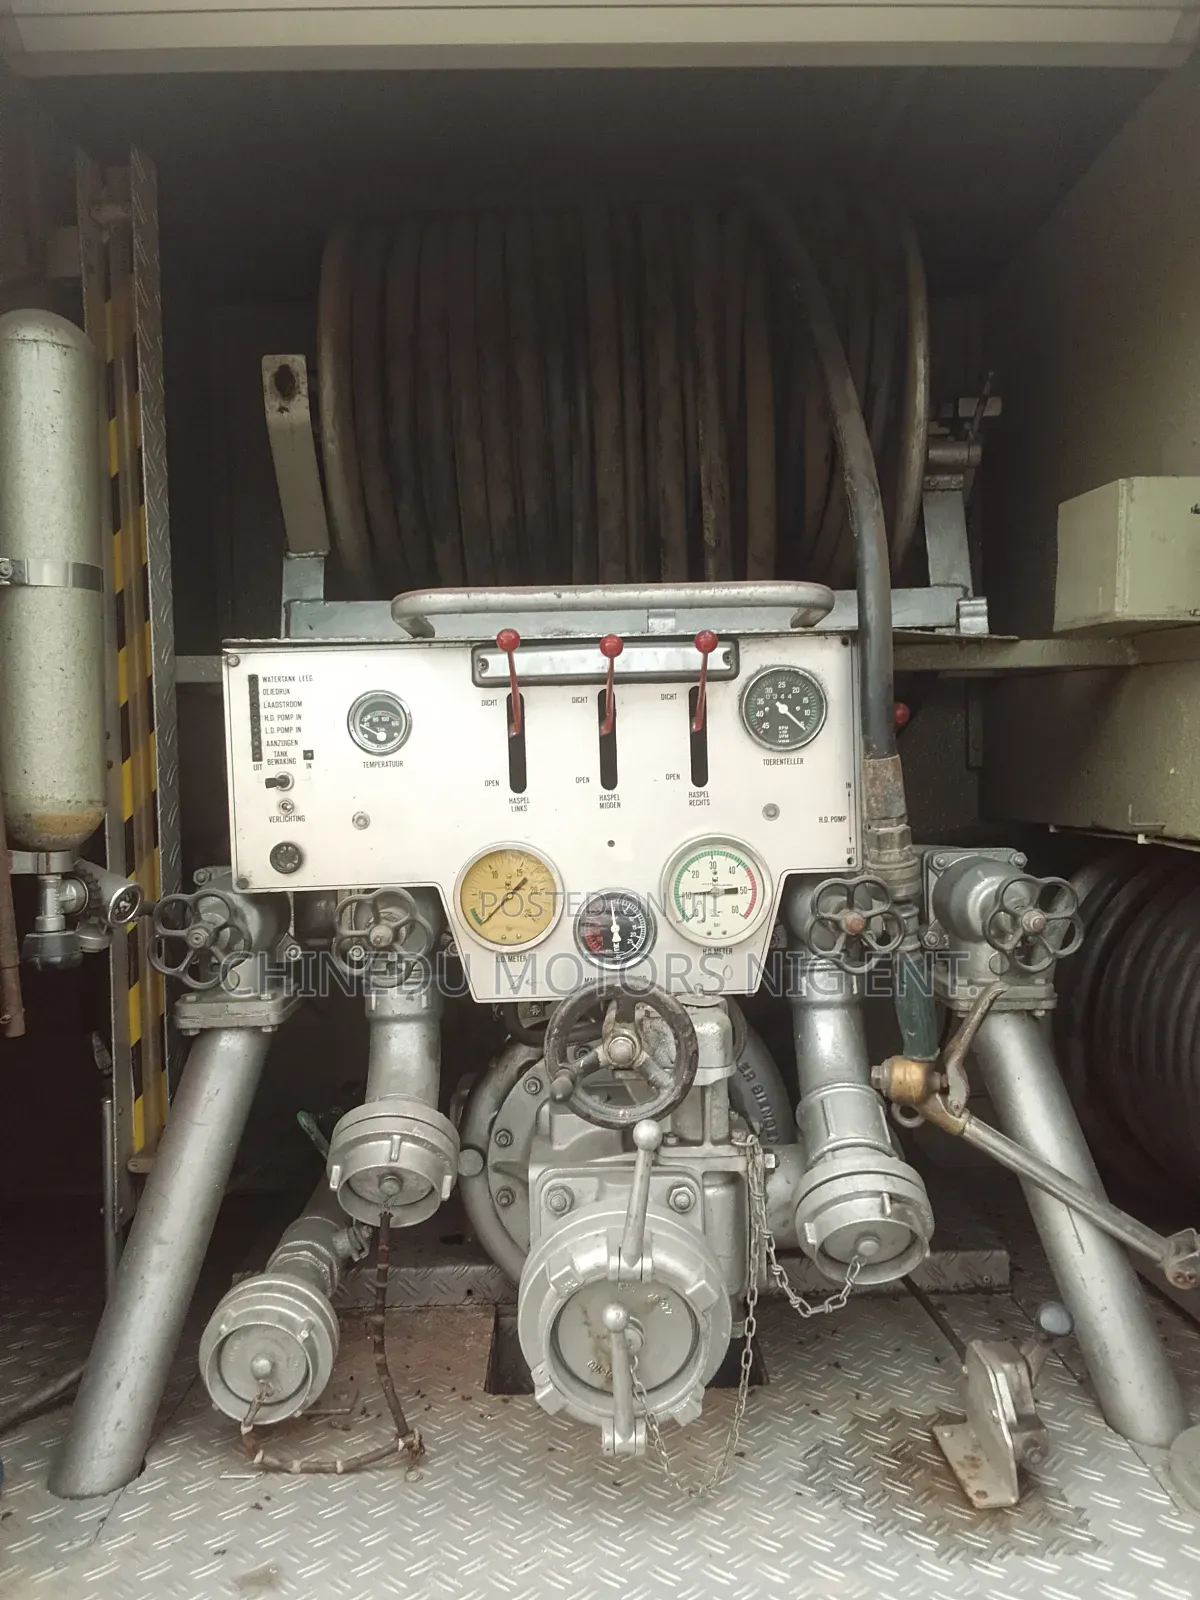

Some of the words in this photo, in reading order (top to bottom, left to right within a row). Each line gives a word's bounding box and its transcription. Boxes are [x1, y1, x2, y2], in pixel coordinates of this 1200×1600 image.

[299, 674, 313, 682] LEEG
[262, 688, 291, 696] OLIEDRUK
[792, 686, 800, 694] 20
[572, 696, 588, 704] DICHT
[661, 693, 677, 701] DICHT
[803, 696, 809, 704] 15
[263, 700, 303, 709] LAADSTROOM
[481, 699, 498, 707] DICHT
[277, 714, 294, 722] POMP
[295, 713, 302, 721] IN
[756, 710, 764, 718] 40
[277, 726, 294, 734] POMP
[266, 739, 299, 747] AANZUIGEN
[273, 750, 289, 758] TANK
[266, 758, 297, 766] BEWAKING
[363, 760, 404, 769] TEMPERATUUR
[763, 757, 804, 766] TOERENTELLER
[253, 763, 263, 771] UIT
[305, 762, 313, 770] IN
[575, 776, 590, 784] OPEN
[665, 773, 681, 781] OPEN
[484, 779, 500, 787] OPEN
[599, 794, 621, 802] HASPEL
[688, 790, 710, 798] HASPEL
[508, 796, 531, 805] HASPEL
[688, 798, 711, 807] RECHTS
[510, 804, 528, 813] LINKS
[599, 801, 622, 810] MIDDEN
[268, 814, 306, 824] VERLICHTING
[830, 815, 847, 823] POMP
[846, 847, 856, 855] UIT
[708, 861, 717, 870] 30
[491, 870, 499, 879] 10
[516, 868, 523, 878] 15
[691, 870, 700, 879] 20
[728, 866, 736, 875] 40
[739, 886, 748, 895] 50
[685, 891, 692, 900] 10
[732, 905, 739, 914] 60
[713, 947, 733, 956] METER
[508, 955, 527, 963] METER
